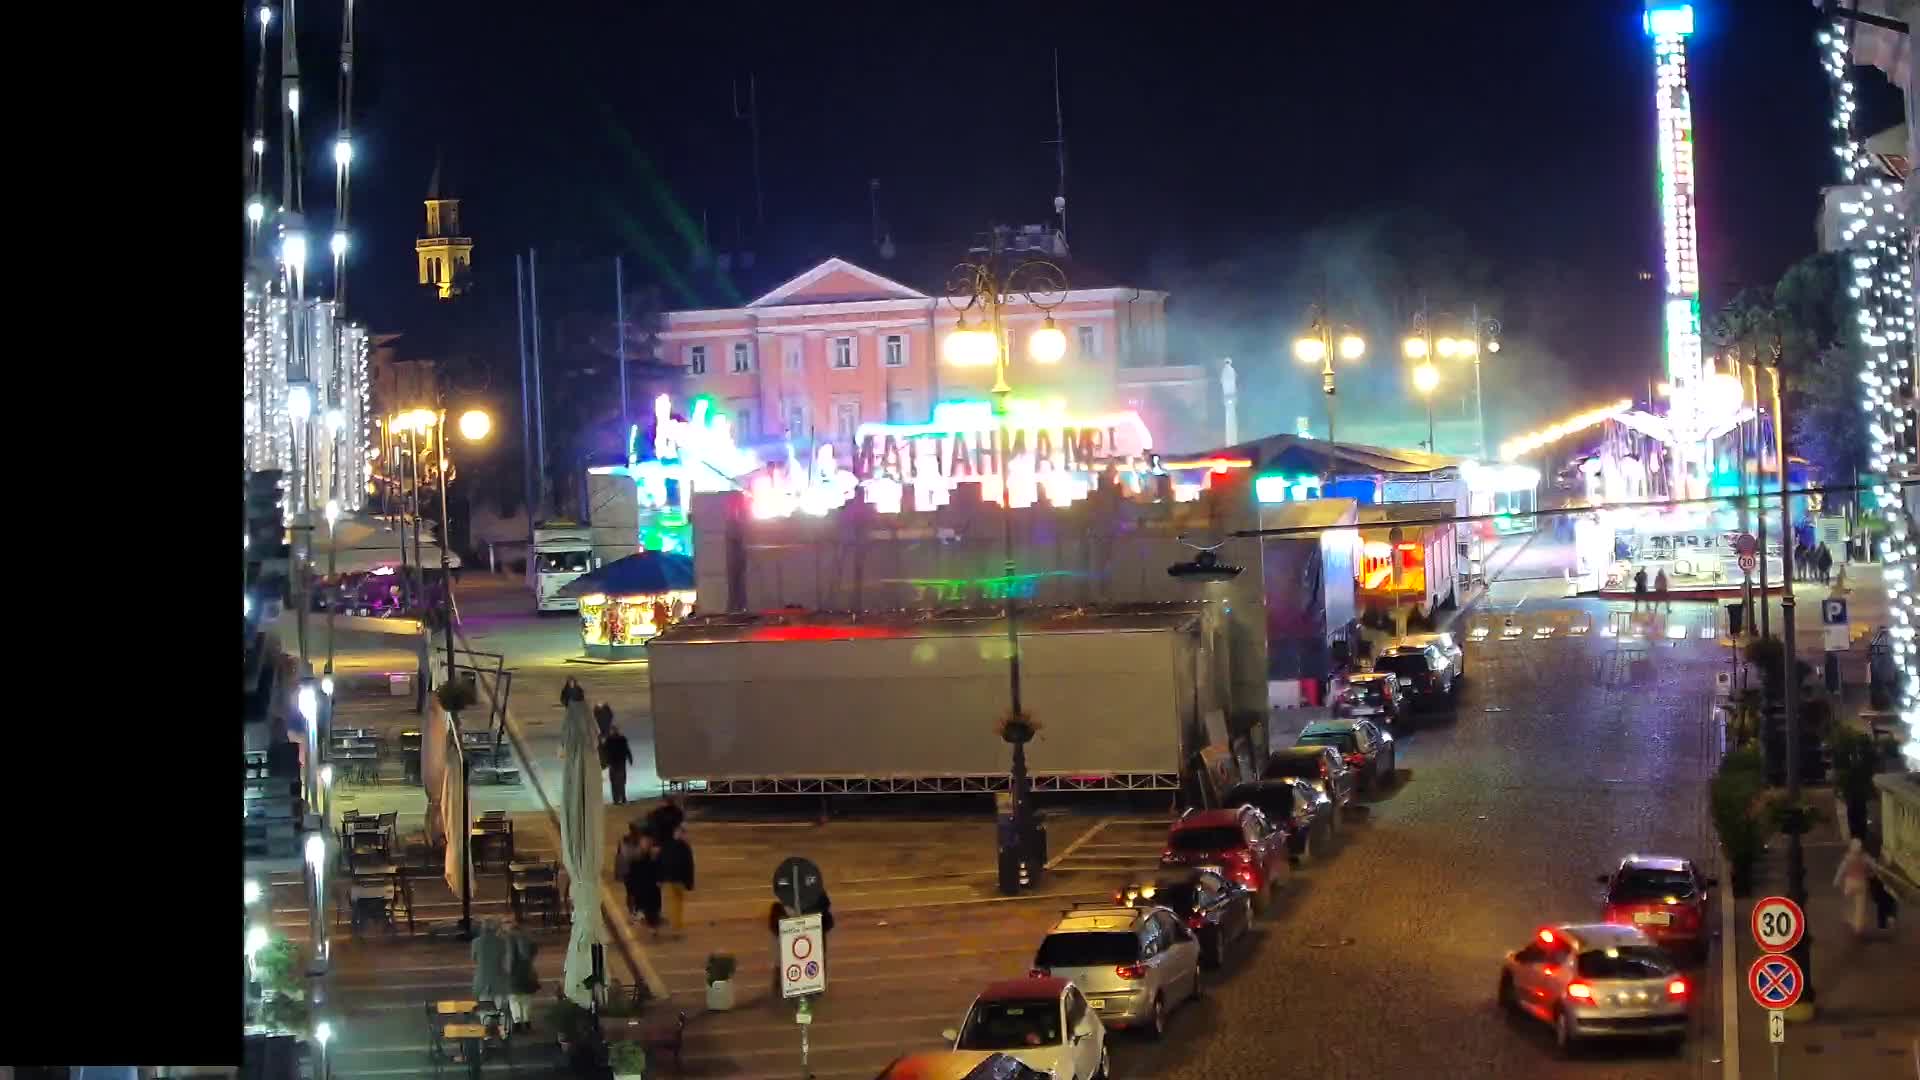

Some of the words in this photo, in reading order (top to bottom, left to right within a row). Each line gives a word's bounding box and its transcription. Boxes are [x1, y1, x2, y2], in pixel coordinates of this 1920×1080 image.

[1742, 557, 1753, 567] 20
[1828, 602, 1842, 622] P
[1763, 912, 1791, 937] 30
